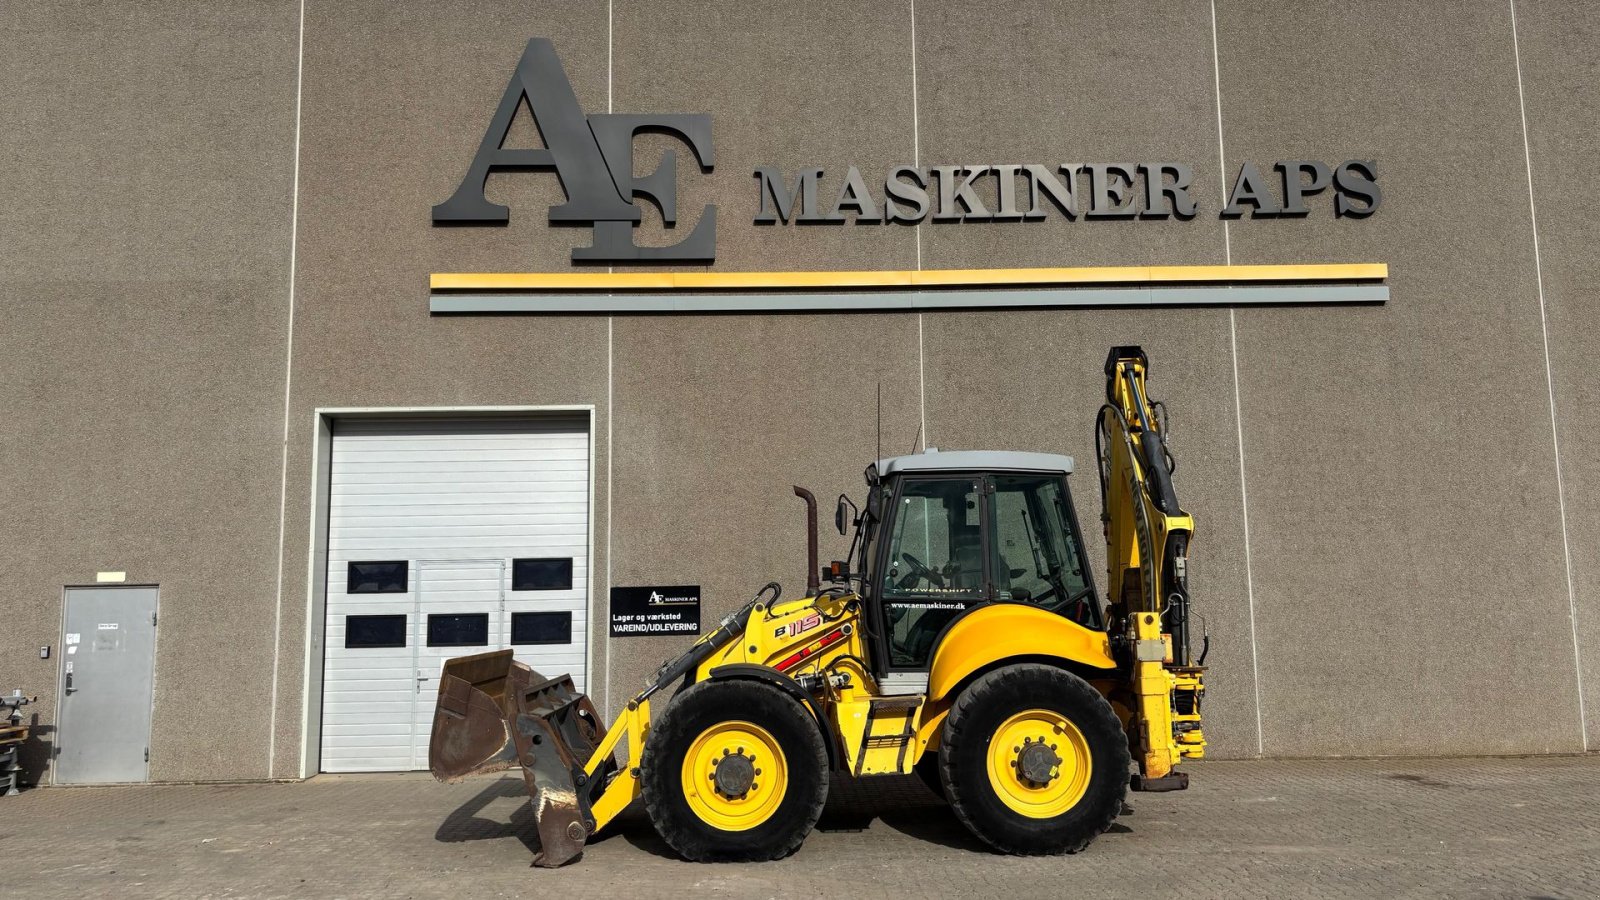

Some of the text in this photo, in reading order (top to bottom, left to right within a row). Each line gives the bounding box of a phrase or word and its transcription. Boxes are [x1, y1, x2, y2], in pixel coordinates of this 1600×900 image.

[432, 37, 1382, 265] AE MASKINER APS
[649, 591, 664, 604] AE
[891, 602, 966, 610] www.aemaskiner.dk
[613, 614, 634, 622] Lager
[647, 612, 681, 620] værksted
[613, 623, 697, 632] VAREIND/UDLEVERING
